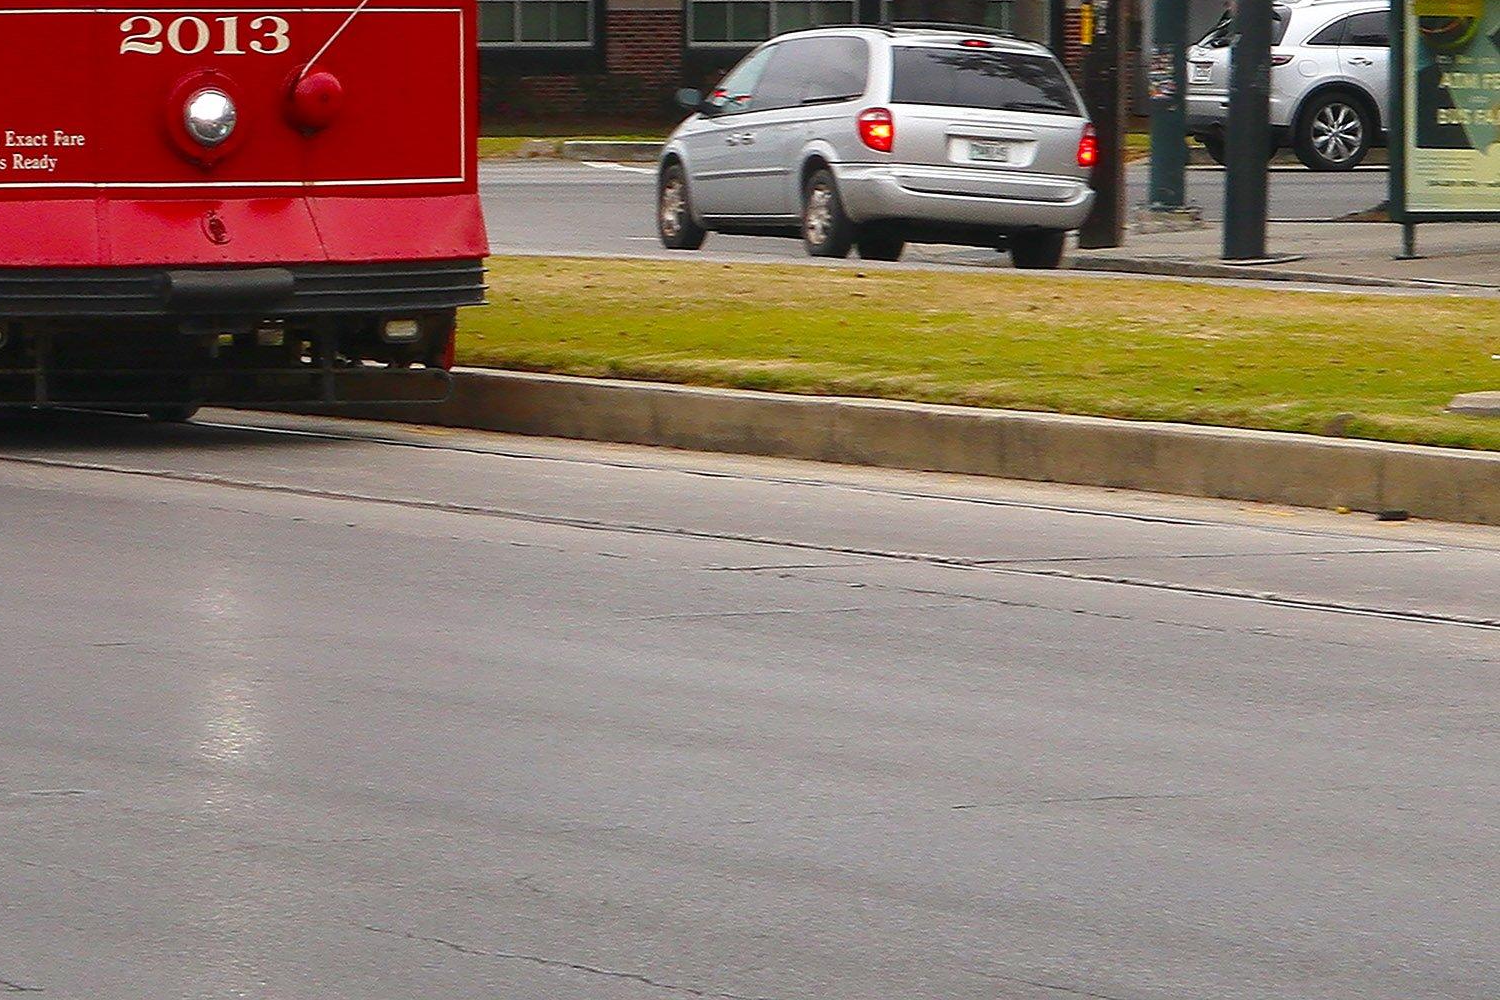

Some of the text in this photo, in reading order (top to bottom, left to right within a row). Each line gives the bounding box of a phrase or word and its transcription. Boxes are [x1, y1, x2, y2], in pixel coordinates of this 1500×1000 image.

[119, 15, 291, 55] 2013
[4, 130, 48, 147] Exact
[53, 130, 86, 146] Fare
[12, 153, 58, 172] Ready
